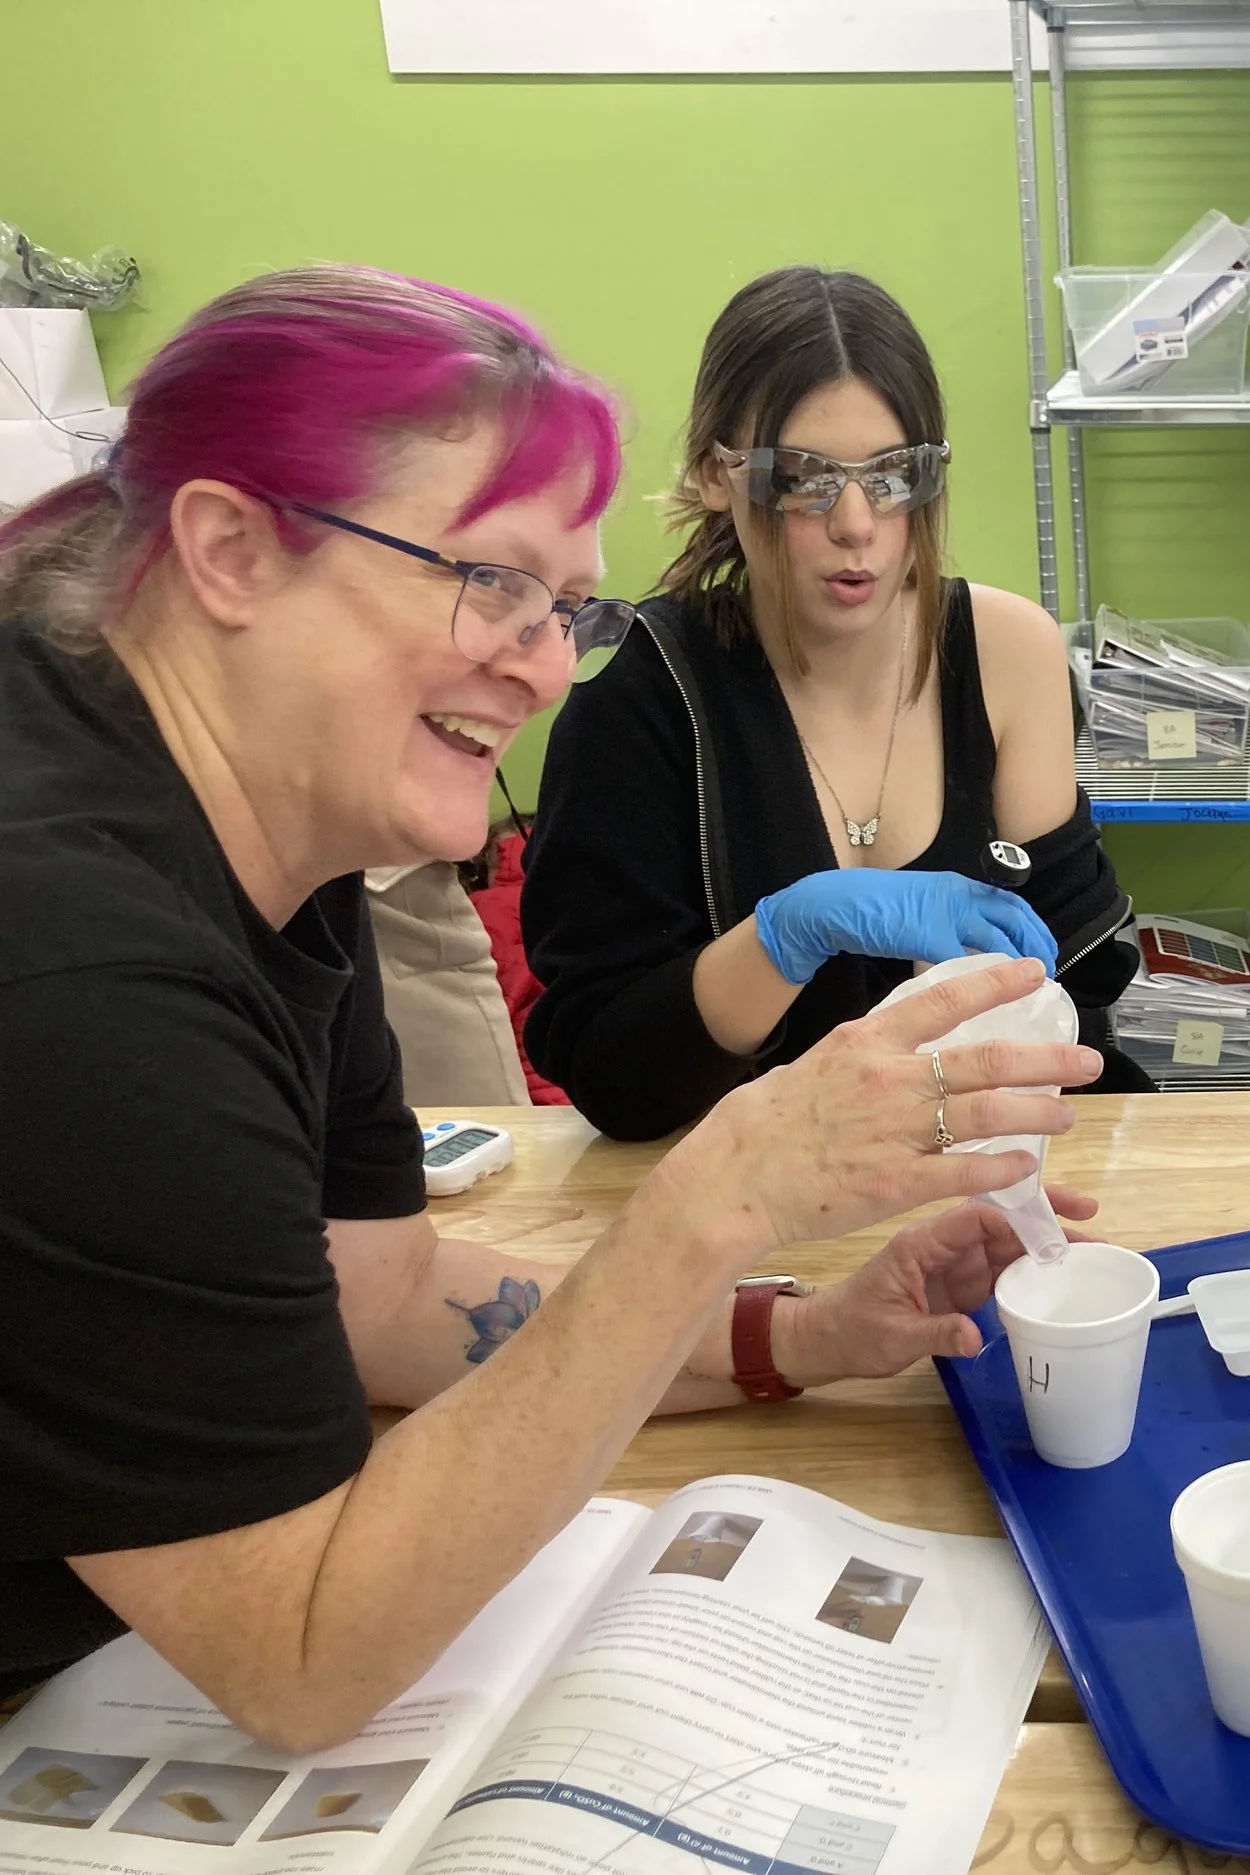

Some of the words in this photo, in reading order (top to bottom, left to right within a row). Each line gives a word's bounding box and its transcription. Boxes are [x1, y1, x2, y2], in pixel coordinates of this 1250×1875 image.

[1027, 1355, 1050, 1395] H
[827, 1785, 872, 1803] procedure
[872, 1795, 908, 1811] General
[613, 1805, 650, 1827] Amount
[701, 1843, 713, 1854] of
[714, 1846, 750, 1866] Amount
